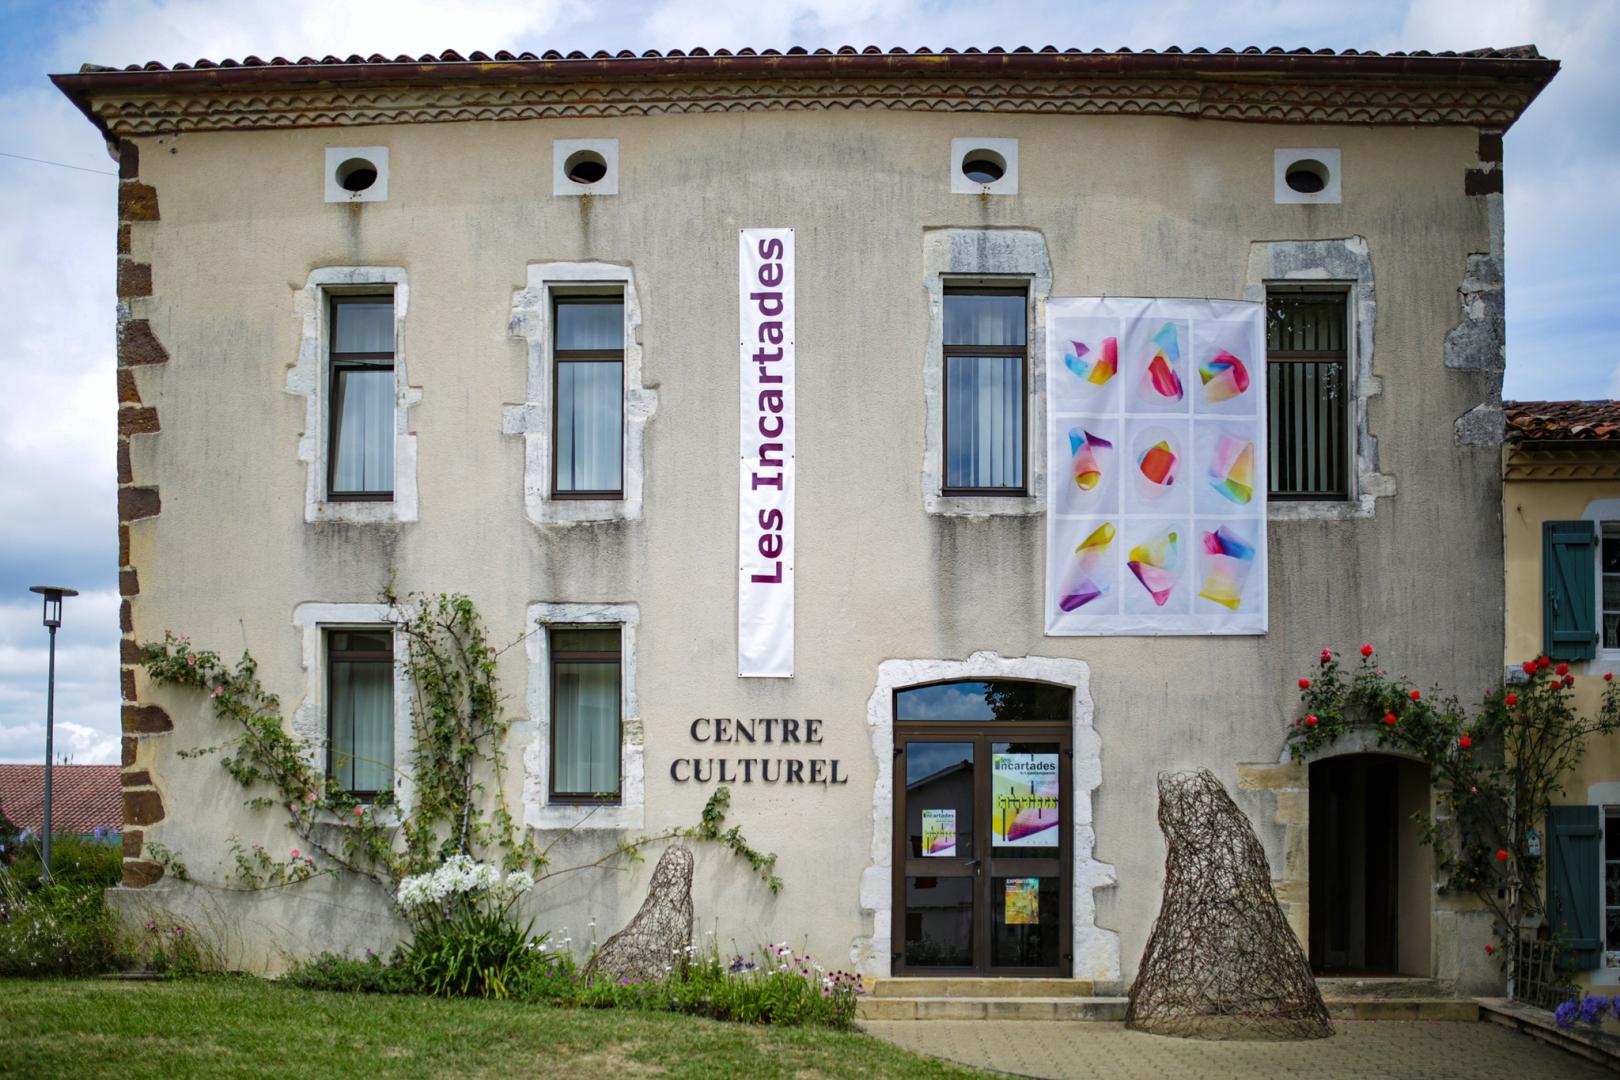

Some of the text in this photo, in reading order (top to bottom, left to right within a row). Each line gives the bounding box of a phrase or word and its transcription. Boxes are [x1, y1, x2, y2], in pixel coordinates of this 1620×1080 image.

[750, 237, 783, 584] Les Incartades
[690, 718, 824, 743] CENTRE
[670, 758, 848, 784] CULTUREL
